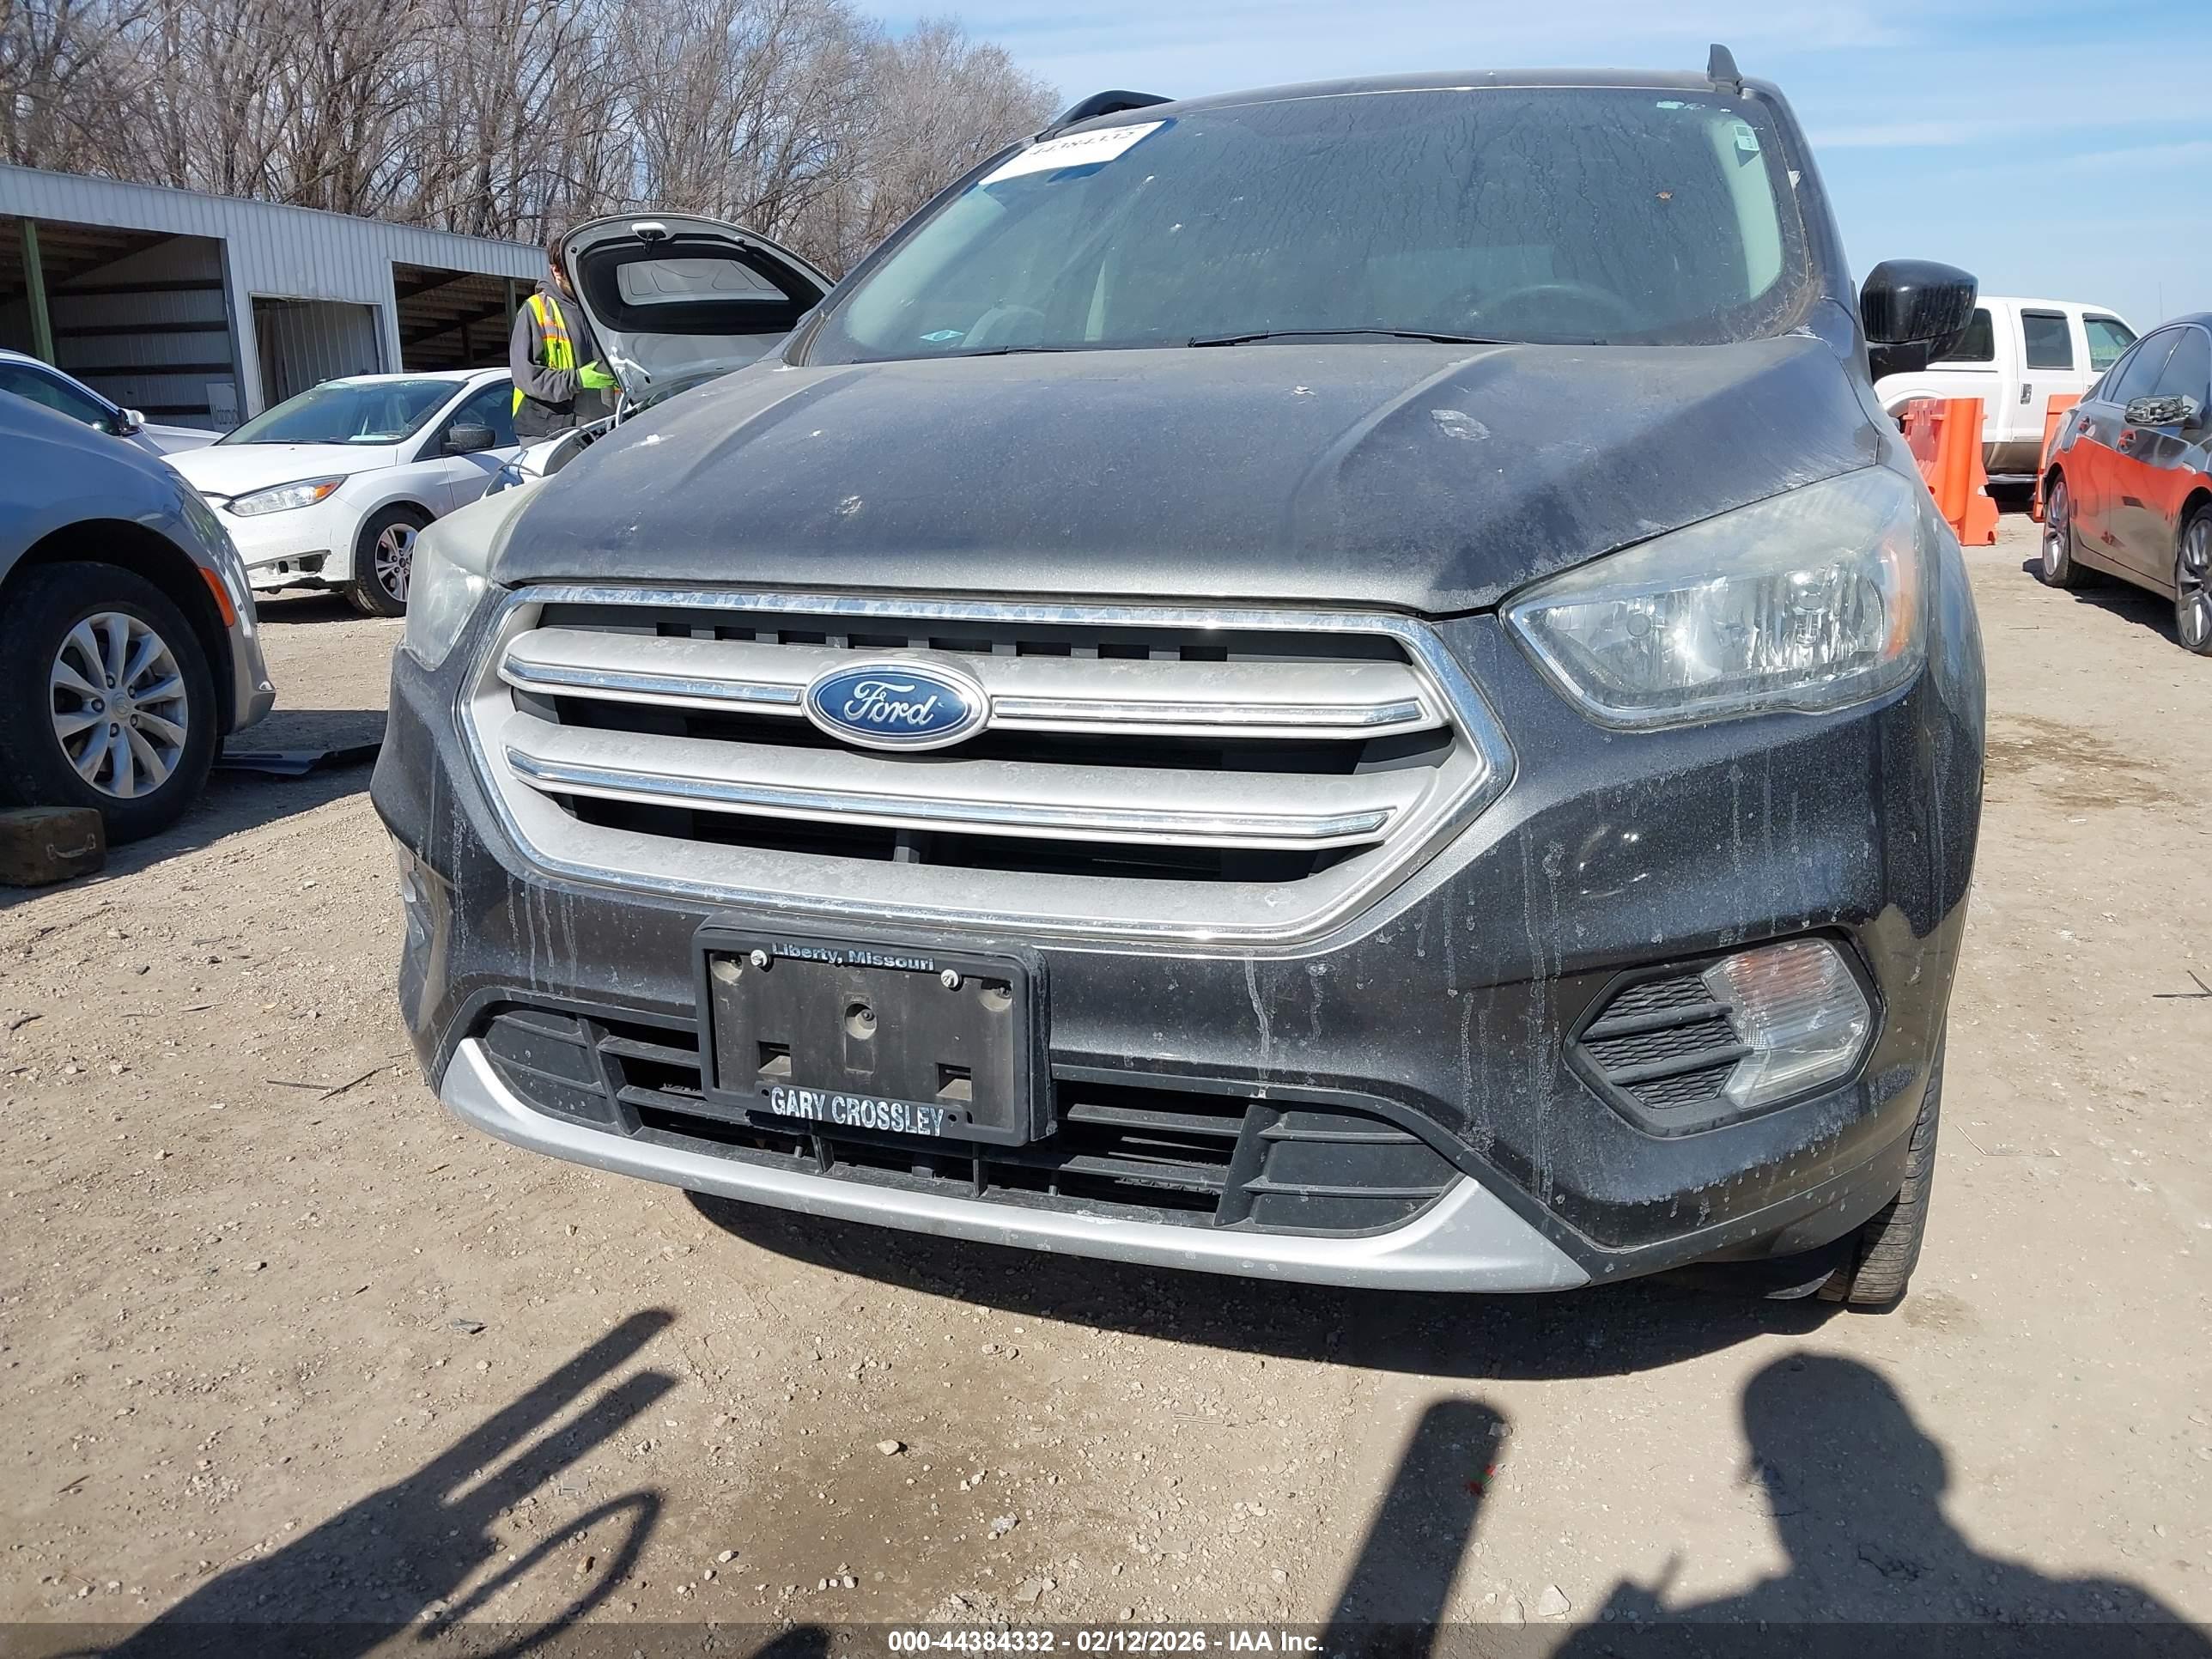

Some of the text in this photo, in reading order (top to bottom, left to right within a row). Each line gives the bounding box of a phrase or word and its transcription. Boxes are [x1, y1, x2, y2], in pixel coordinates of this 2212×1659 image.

[844, 680, 939, 726] Ford
[772, 943, 935, 971] Liberty, Missouri
[771, 1086, 945, 1137] GARY CROSSLEY
